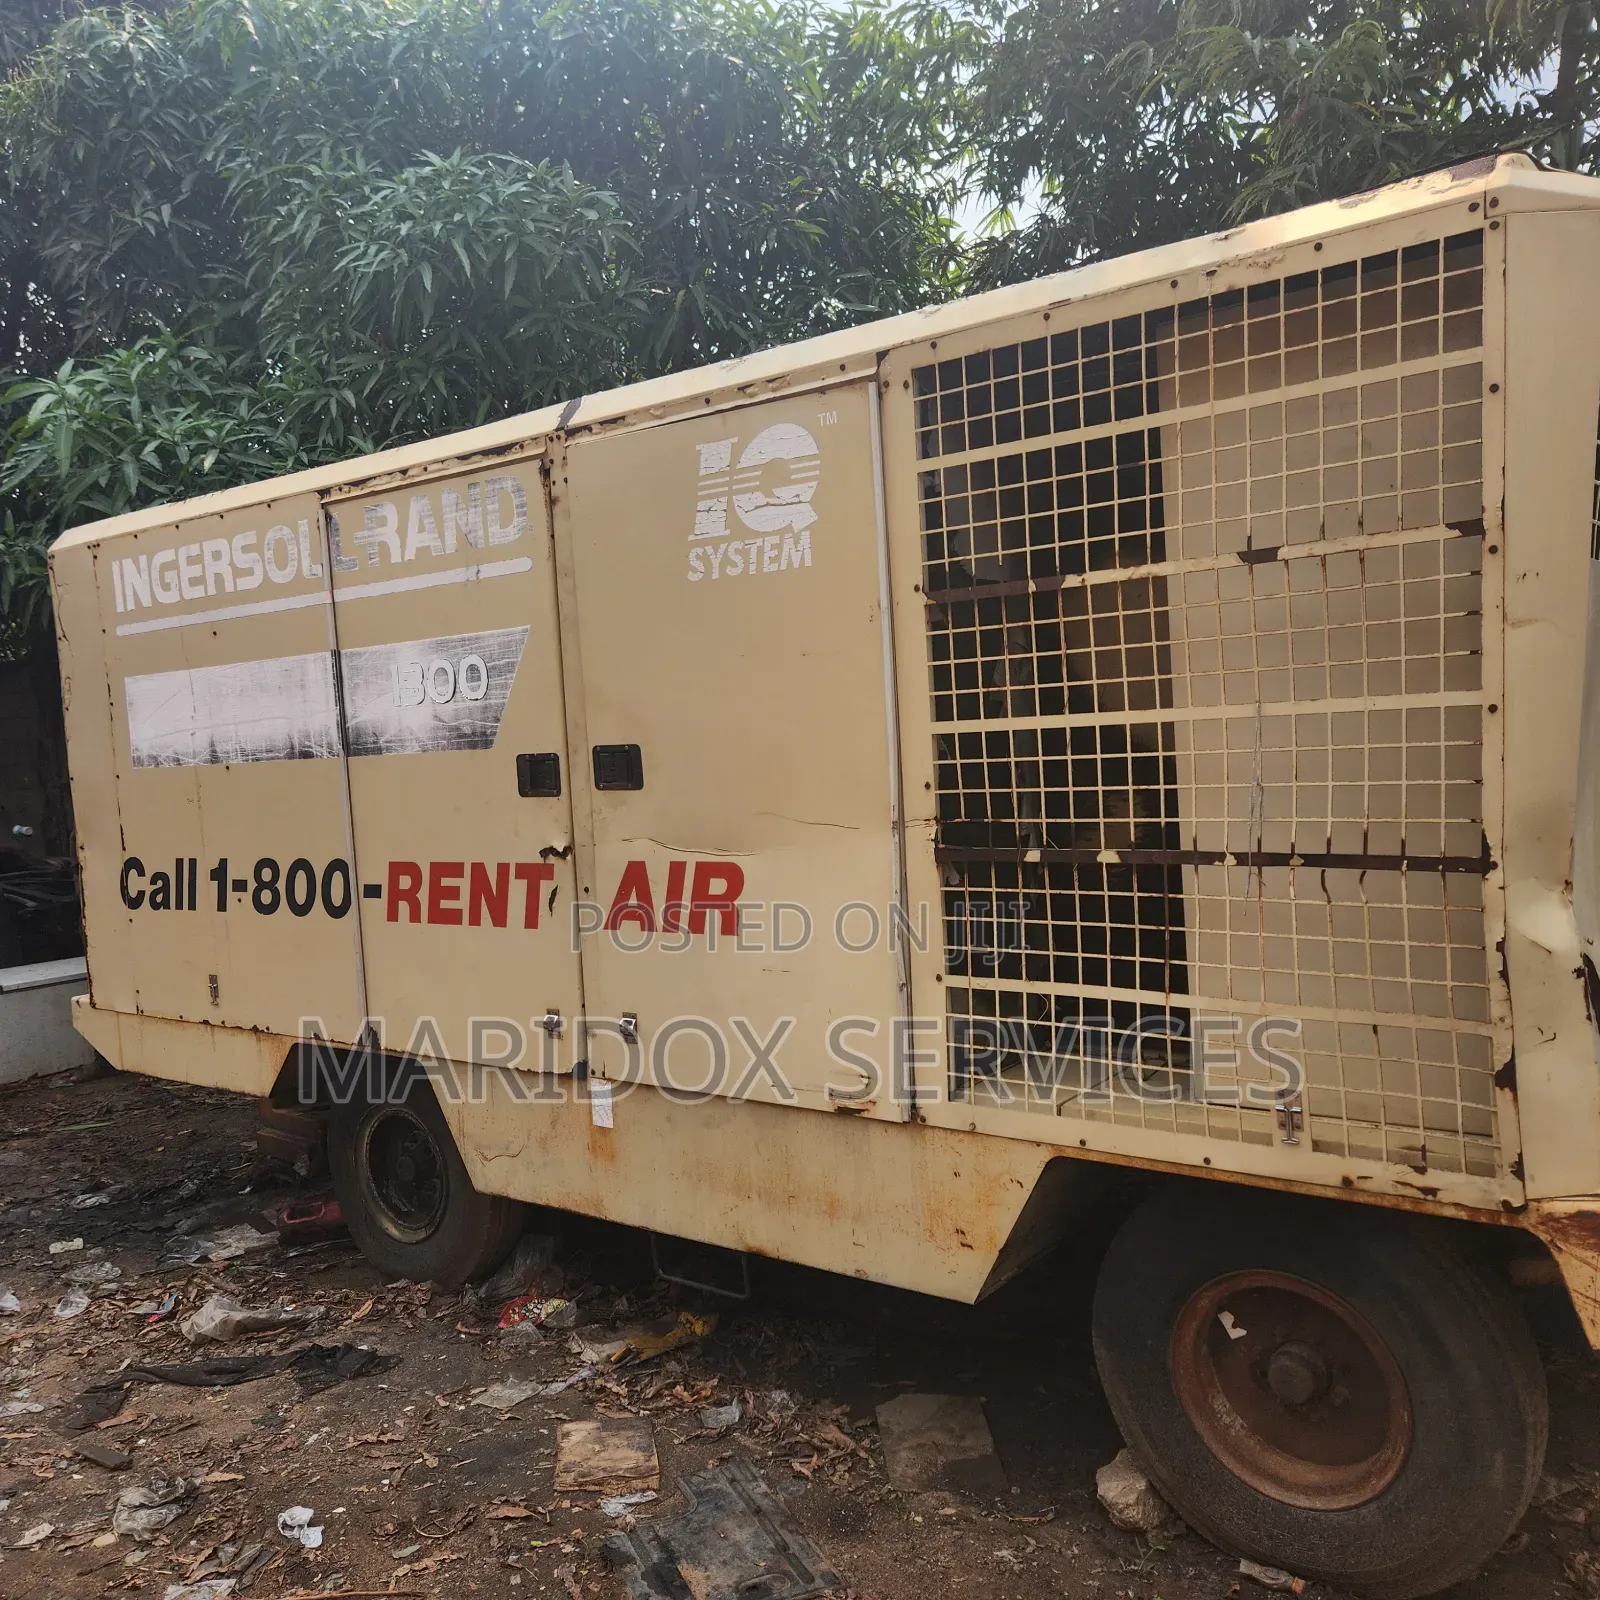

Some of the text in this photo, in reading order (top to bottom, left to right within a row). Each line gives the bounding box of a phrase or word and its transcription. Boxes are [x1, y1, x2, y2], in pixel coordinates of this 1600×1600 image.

[818, 411, 837, 427] TM
[687, 530, 812, 581] SYSTEM
[120, 857, 198, 912] Call
[602, 860, 745, 936] AIR
